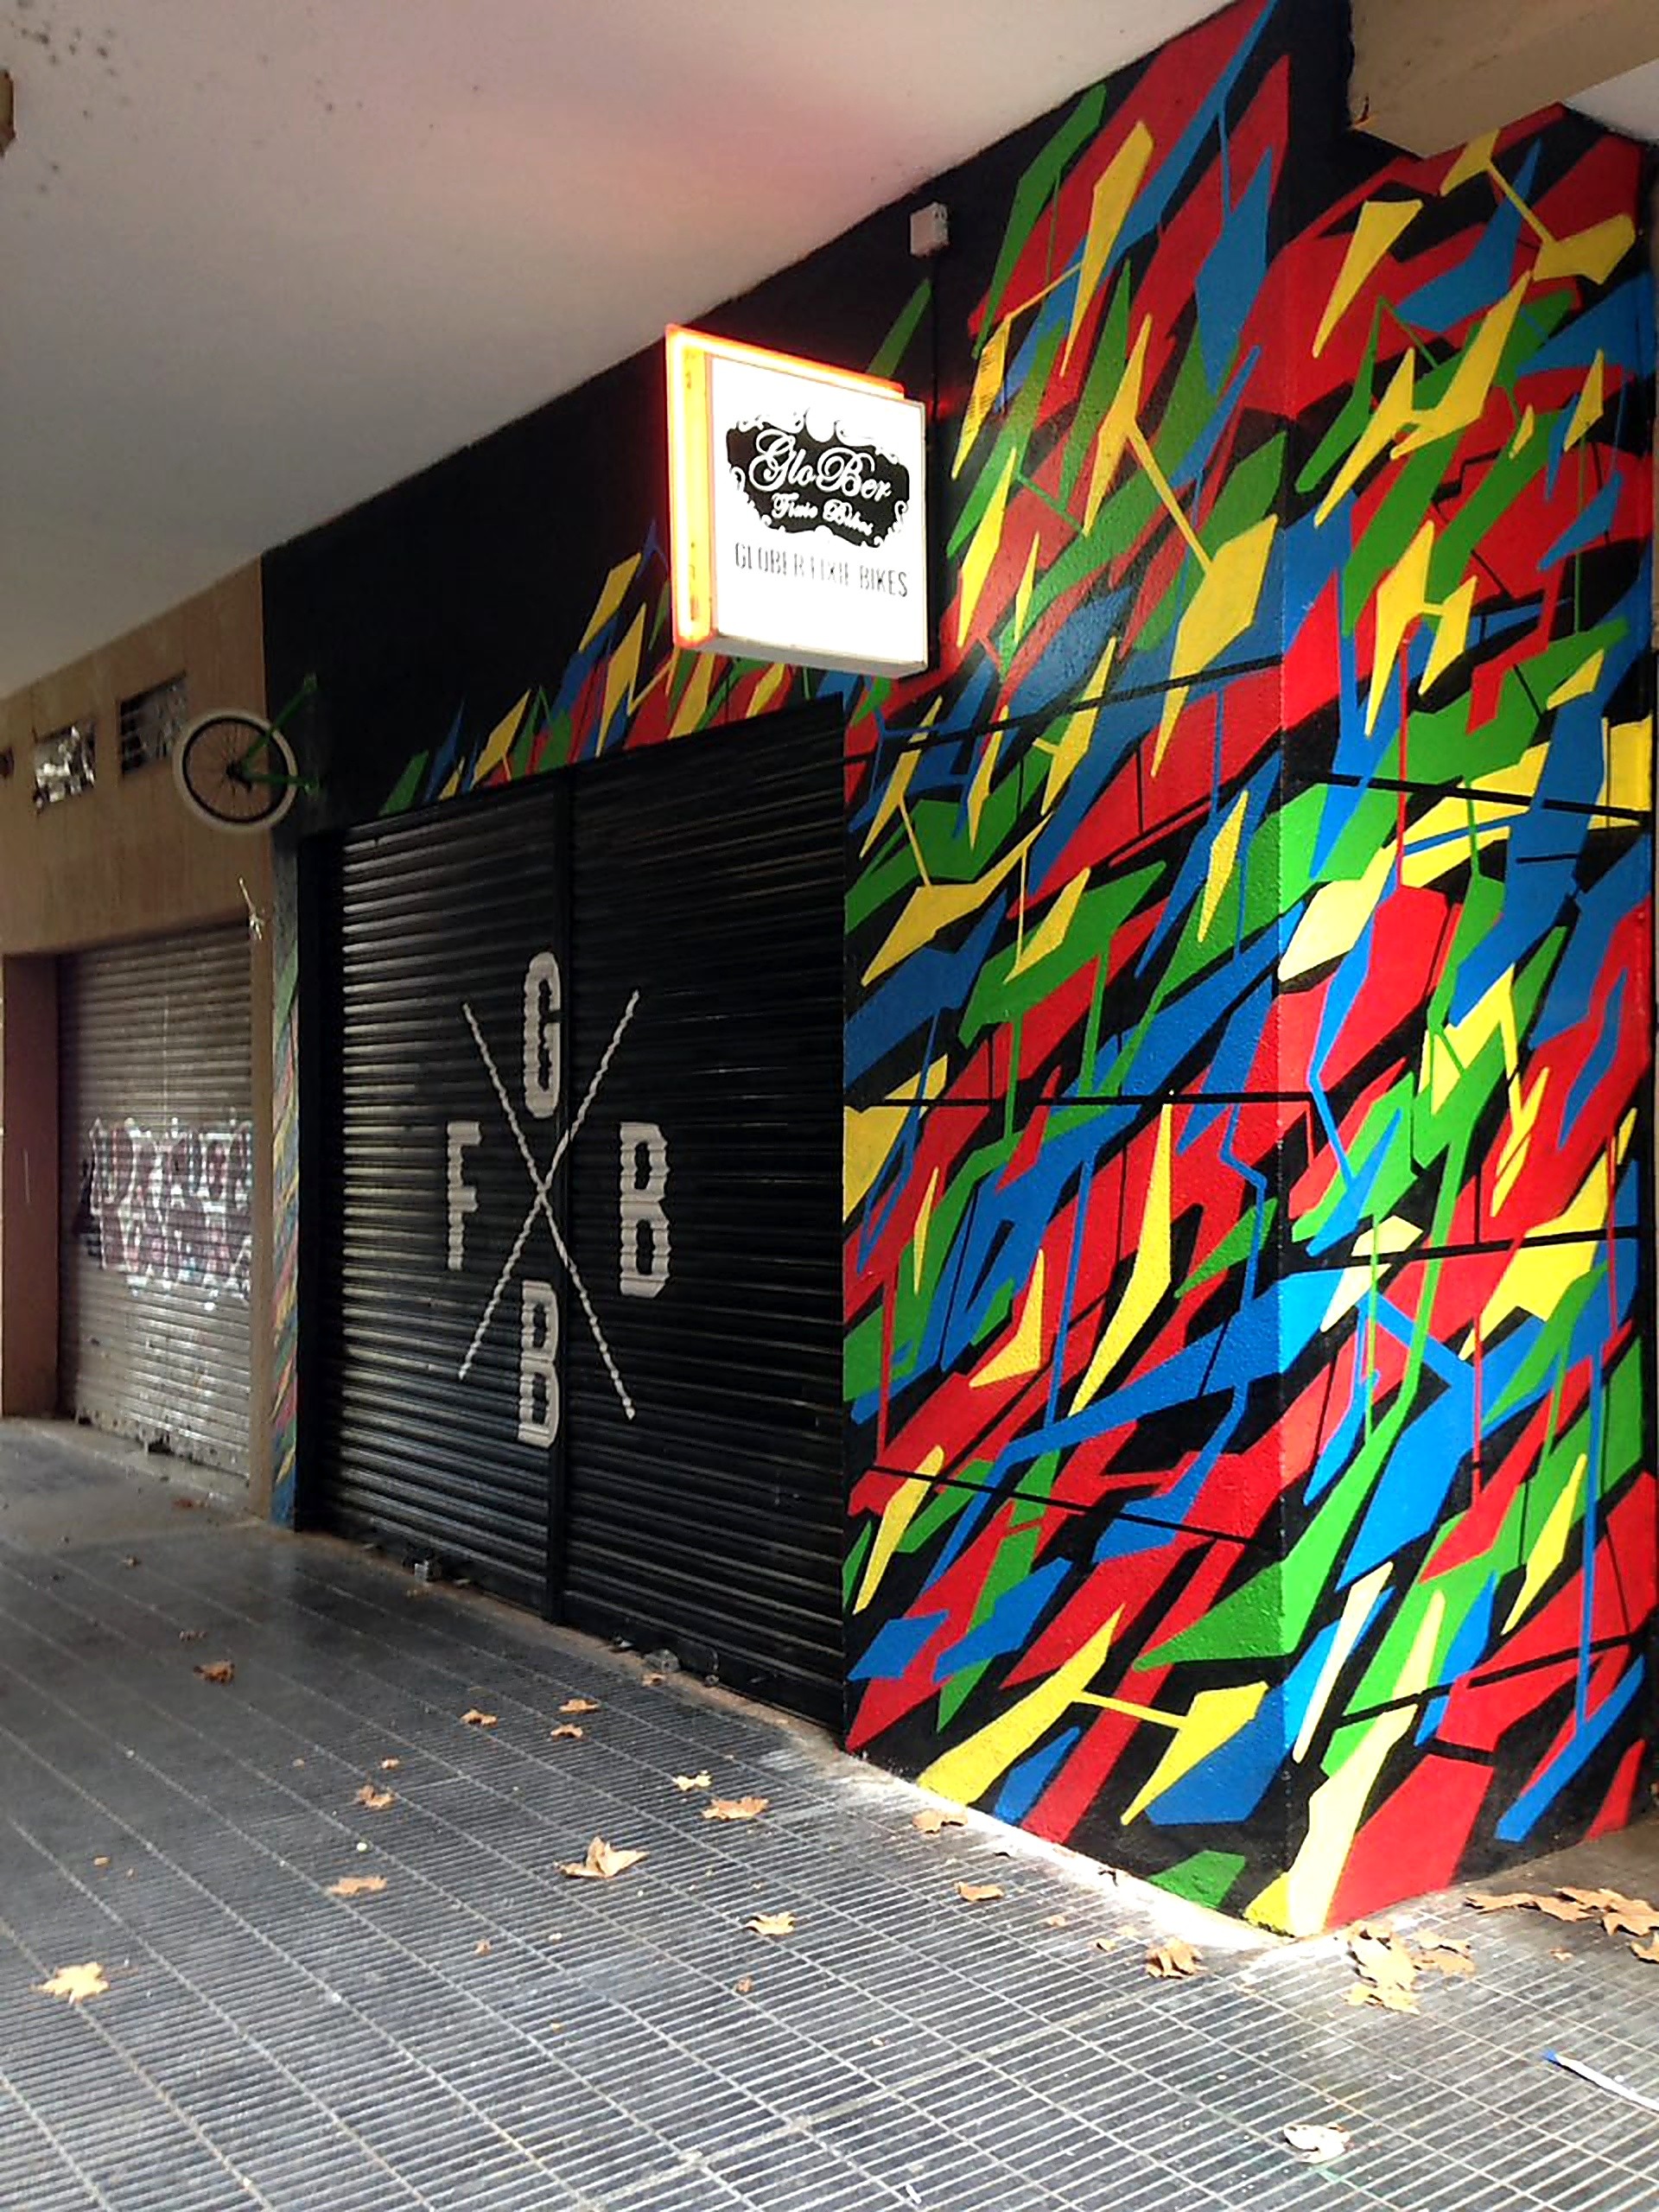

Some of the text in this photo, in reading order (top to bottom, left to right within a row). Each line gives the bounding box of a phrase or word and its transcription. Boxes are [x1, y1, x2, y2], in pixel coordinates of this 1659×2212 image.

[748, 429, 892, 501] GloBer
[734, 542, 804, 577] GLOBER
[859, 564, 908, 598] BIKES
[524, 951, 561, 1118] G
[447, 1121, 482, 1271] F
[619, 1122, 671, 1297] B
[518, 1280, 560, 1448] B
